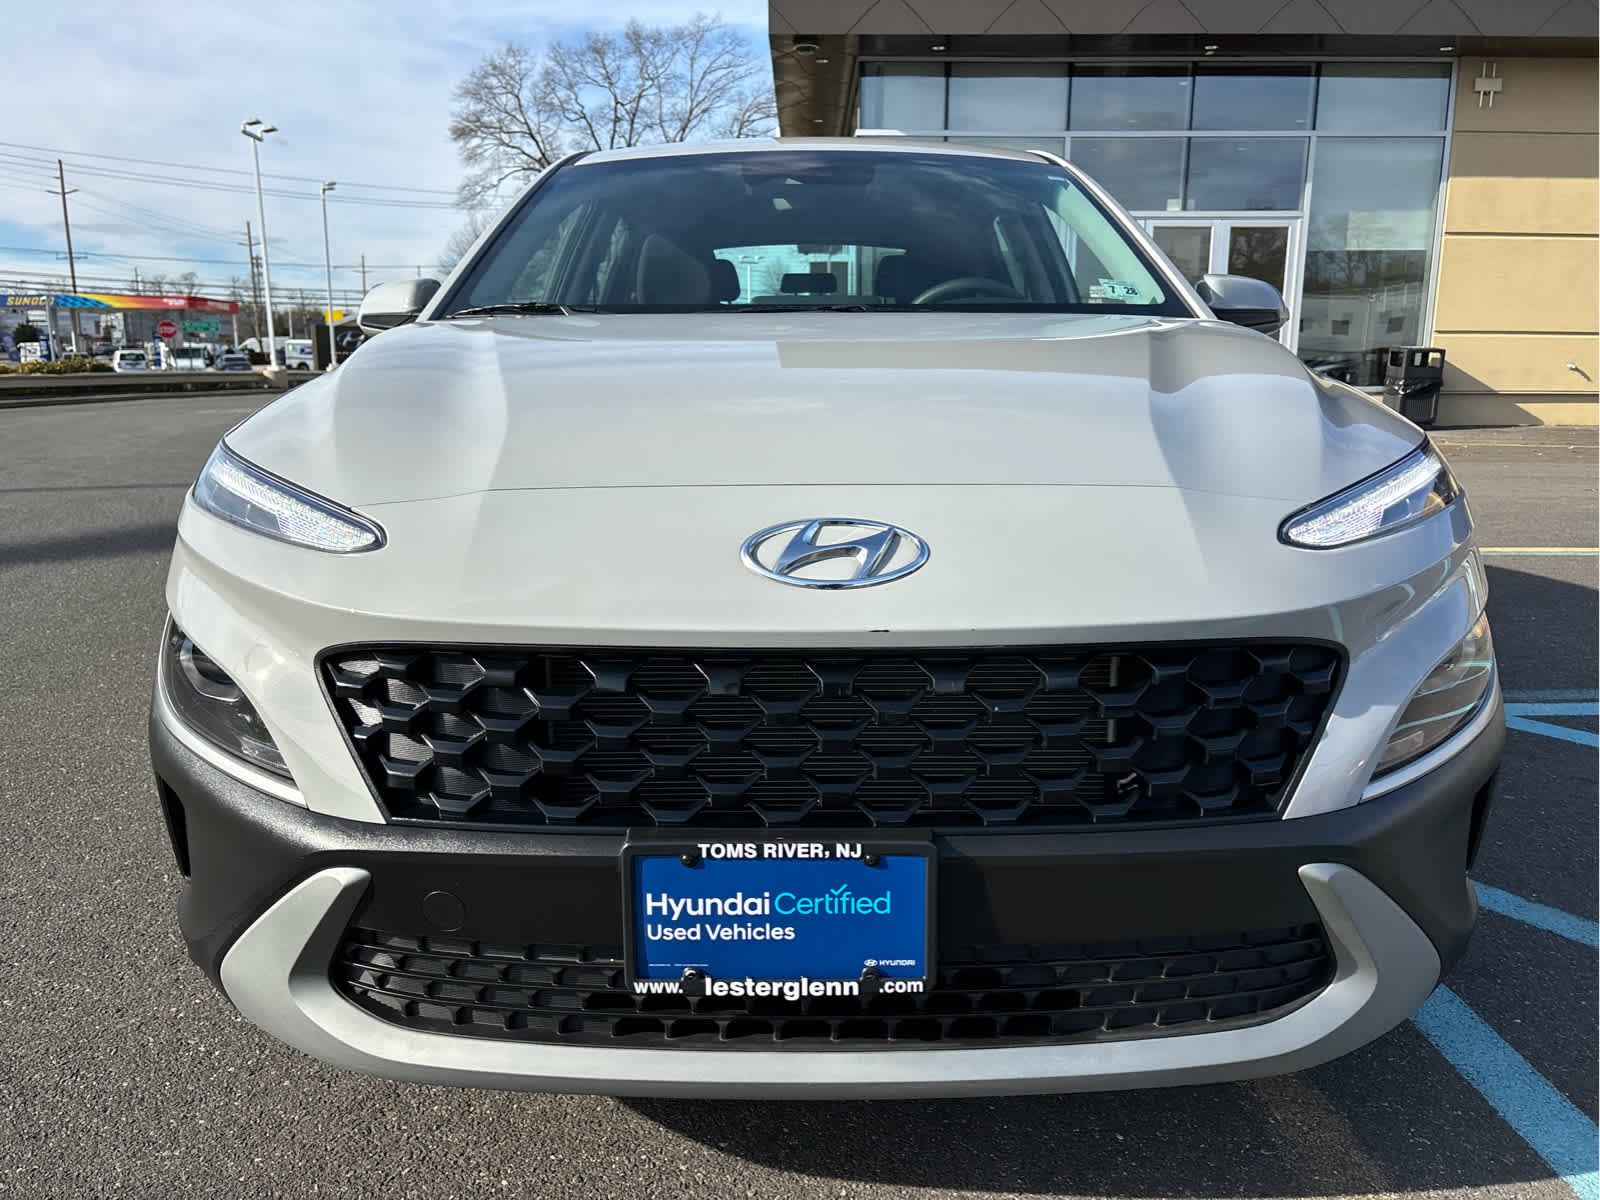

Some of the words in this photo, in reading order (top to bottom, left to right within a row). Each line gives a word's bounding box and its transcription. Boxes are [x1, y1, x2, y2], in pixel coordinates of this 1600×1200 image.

[698, 843, 758, 858] TOMS
[763, 843, 830, 859] RIVER,
[836, 843, 863, 858] NJ
[646, 891, 770, 920] Hyundai
[774, 884, 891, 915] Certified
[647, 923, 701, 940] Used
[706, 923, 796, 940] Vehicles
[633, 981, 684, 994] www.
[705, 977, 859, 1000] lesterglenn
[878, 979, 924, 993] .com
